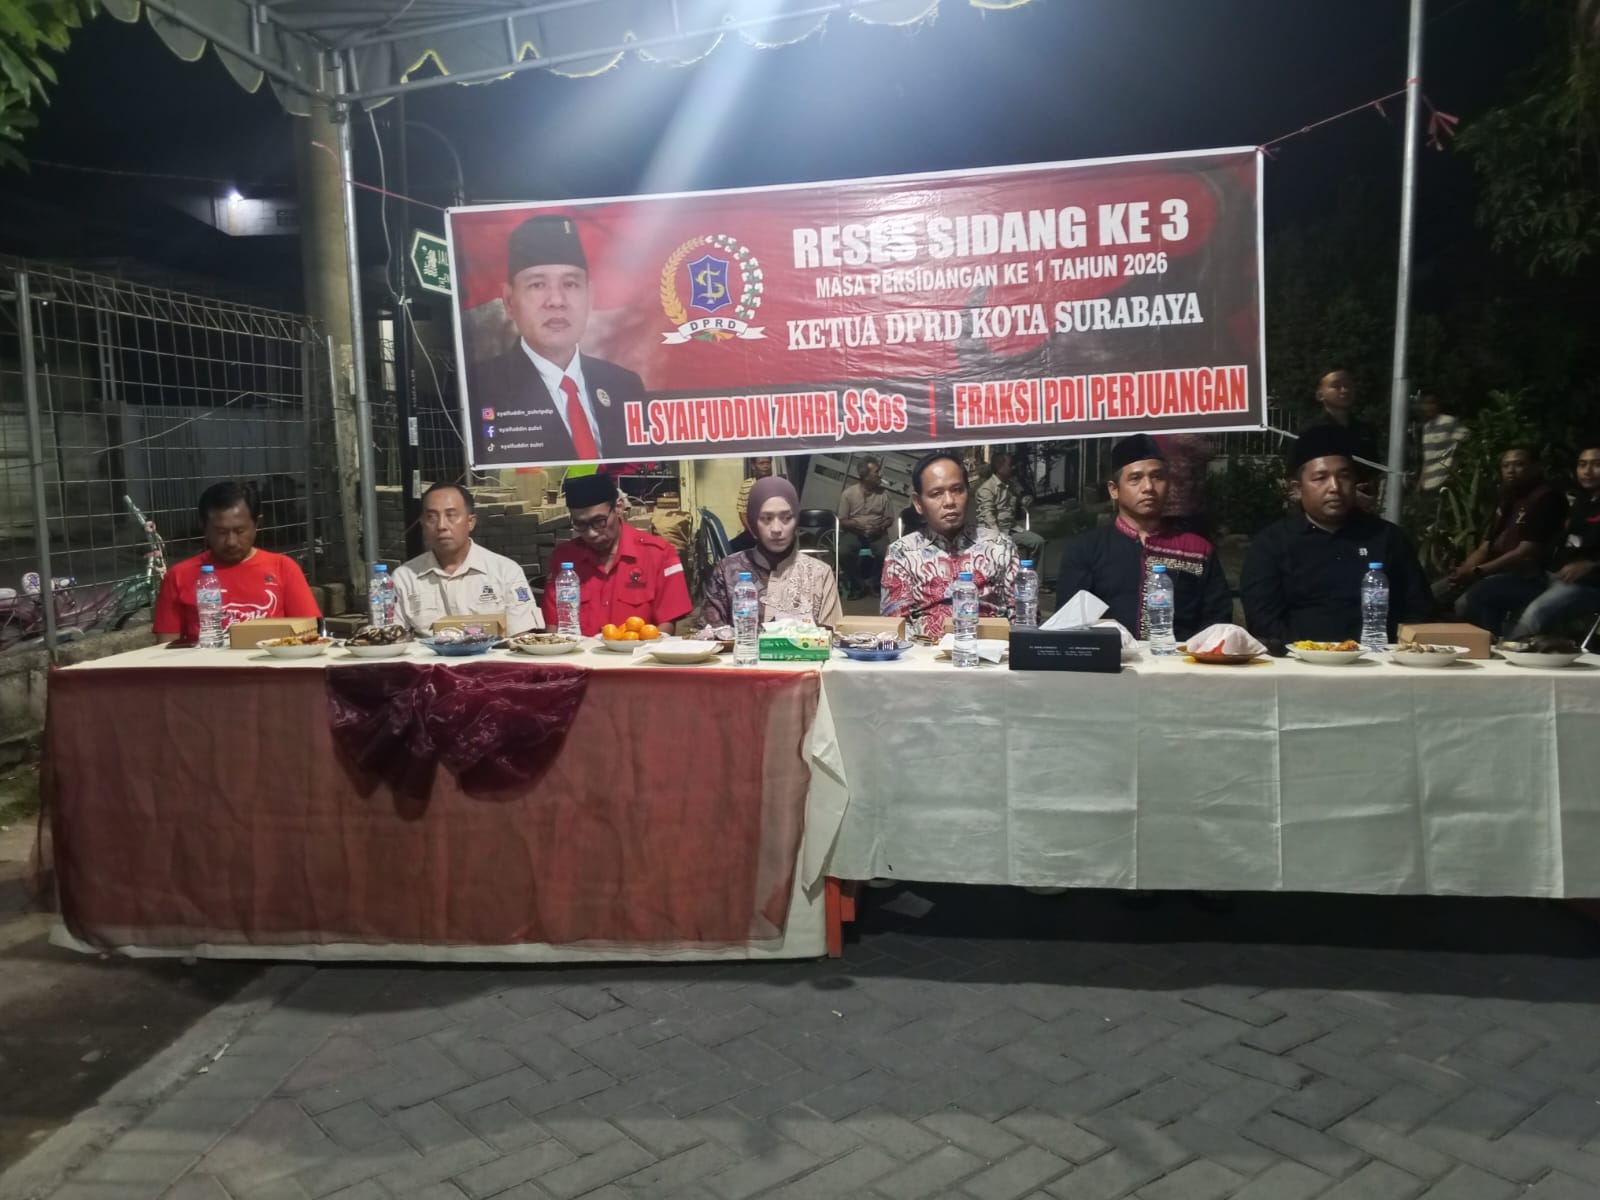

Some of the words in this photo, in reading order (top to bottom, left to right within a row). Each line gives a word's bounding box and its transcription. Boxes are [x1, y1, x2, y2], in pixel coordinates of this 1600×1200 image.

[793, 217, 918, 269] RESES
[926, 206, 1088, 259] SIDANG
[1098, 202, 1151, 246] KE
[1160, 198, 1190, 241] 3
[816, 274, 866, 299] MASA
[869, 264, 999, 295] PERSIDANGAN
[1004, 262, 1029, 285] KE
[1034, 260, 1045, 282] 1
[1051, 254, 1119, 281] TAHUN
[1123, 252, 1168, 276] 2026
[690, 318, 737, 332] DPRD
[786, 315, 881, 351] KETUA
[884, 310, 963, 345] DPRD
[970, 303, 1049, 339] KOTA
[1055, 292, 1204, 334] SURABAYA
[624, 401, 651, 446] H.
[648, 395, 774, 445] SYAIFUDDIN
[771, 391, 845, 441] ZUHRI,
[953, 378, 1042, 429] FRAKSI
[1042, 375, 1088, 424] PDI
[1088, 365, 1249, 421] PERJUANGAN
